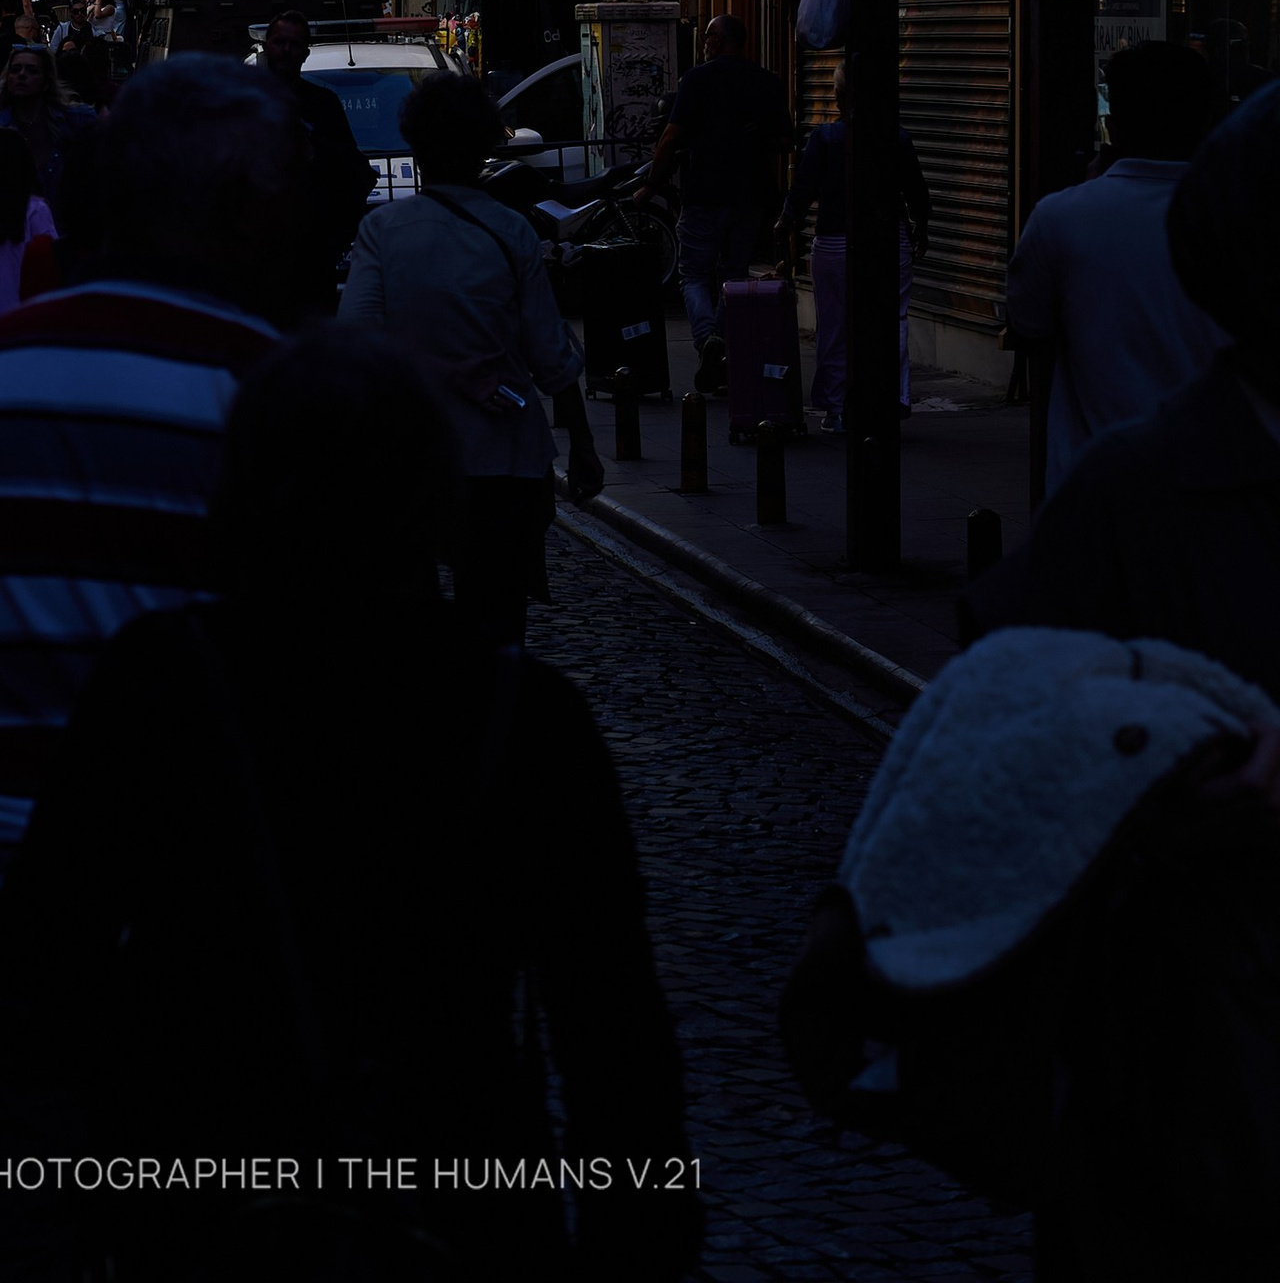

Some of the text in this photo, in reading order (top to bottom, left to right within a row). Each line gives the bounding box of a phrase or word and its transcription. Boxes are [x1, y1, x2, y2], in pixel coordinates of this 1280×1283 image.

[1094, 18, 1125, 51] İRALIK
[356, 98, 362, 110] A
[365, 97, 377, 110] 34
